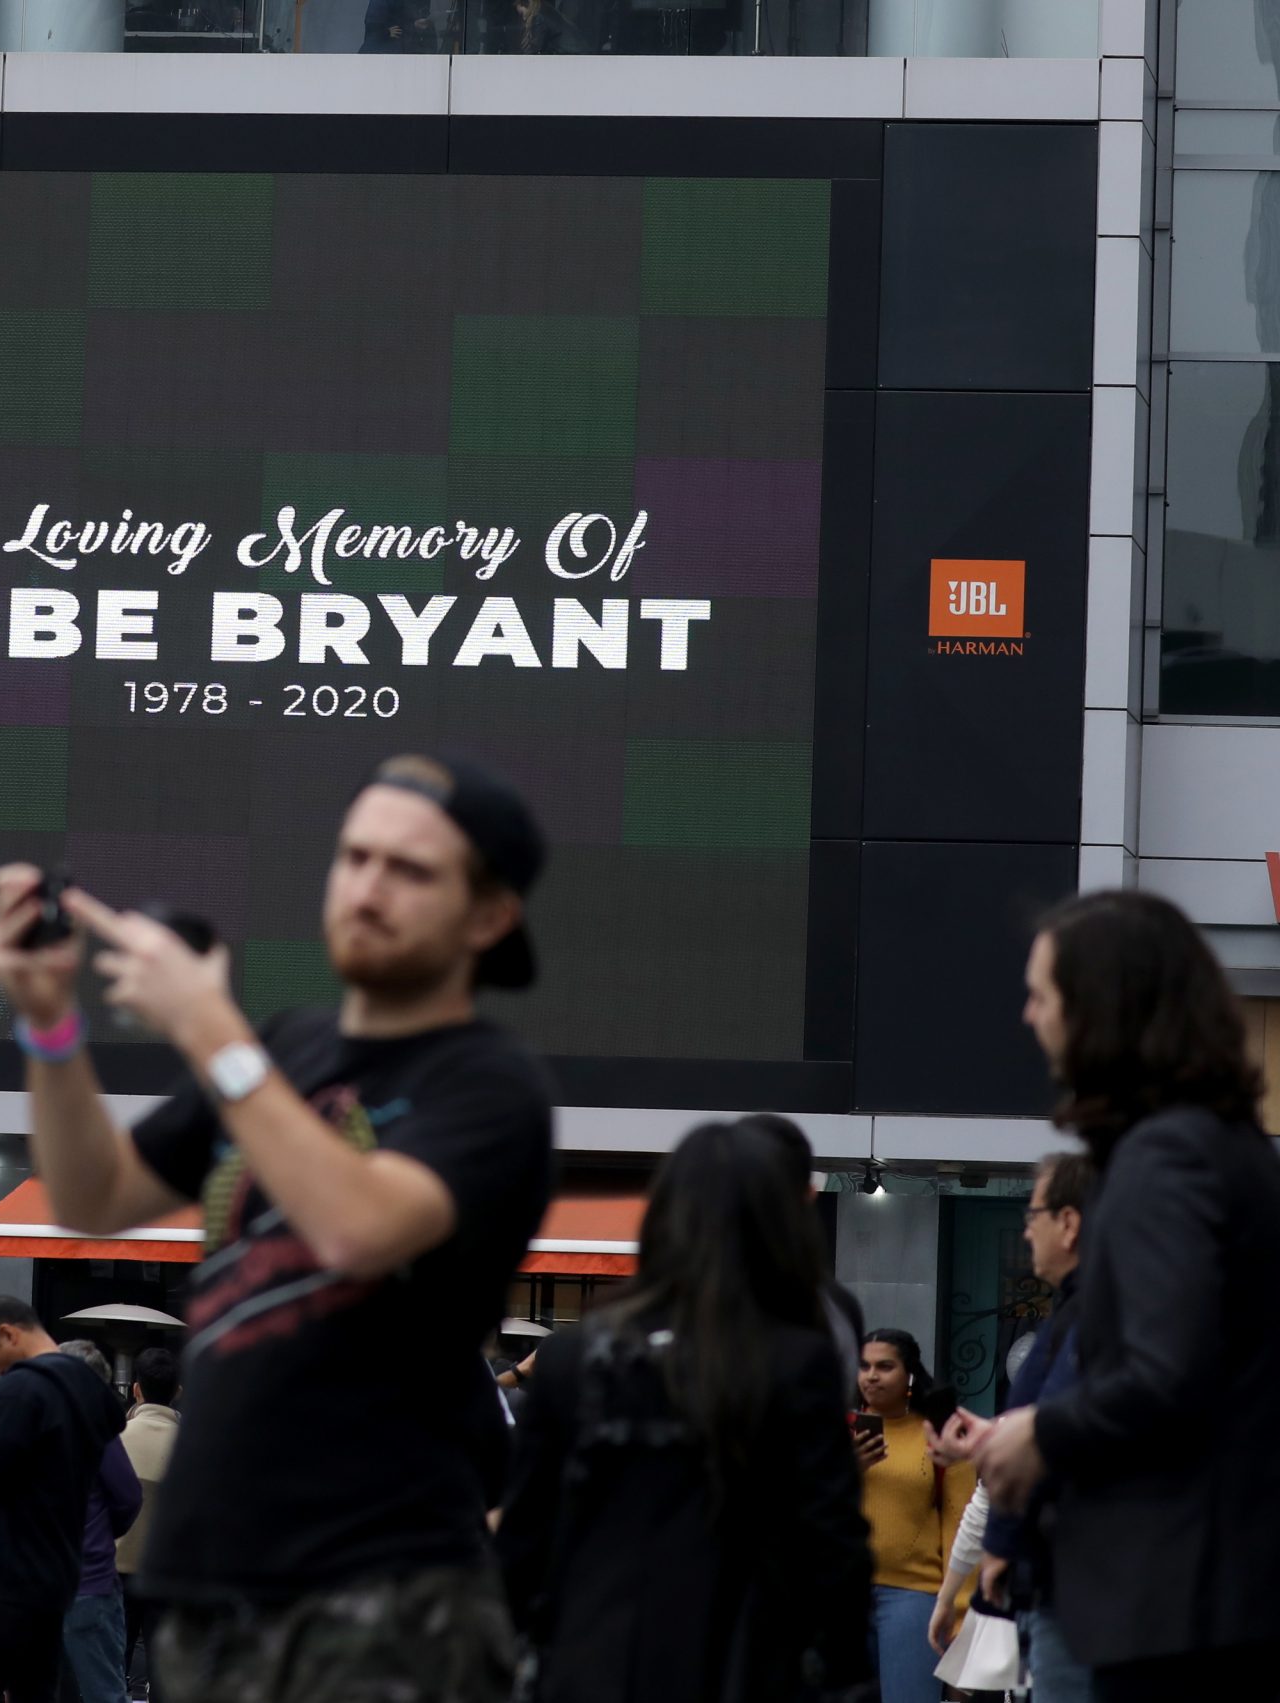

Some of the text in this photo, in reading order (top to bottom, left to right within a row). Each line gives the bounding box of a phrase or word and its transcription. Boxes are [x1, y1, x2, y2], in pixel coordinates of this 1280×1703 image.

[3, 504, 212, 575] Loving
[237, 506, 521, 585] Memory
[545, 510, 648, 581] Of
[948, 581, 1007, 616] JBL
[211, 592, 711, 670] BRYANT
[937, 641, 1024, 656] HARMAN
[124, 681, 228, 715] 1978
[282, 684, 400, 718] 2020
